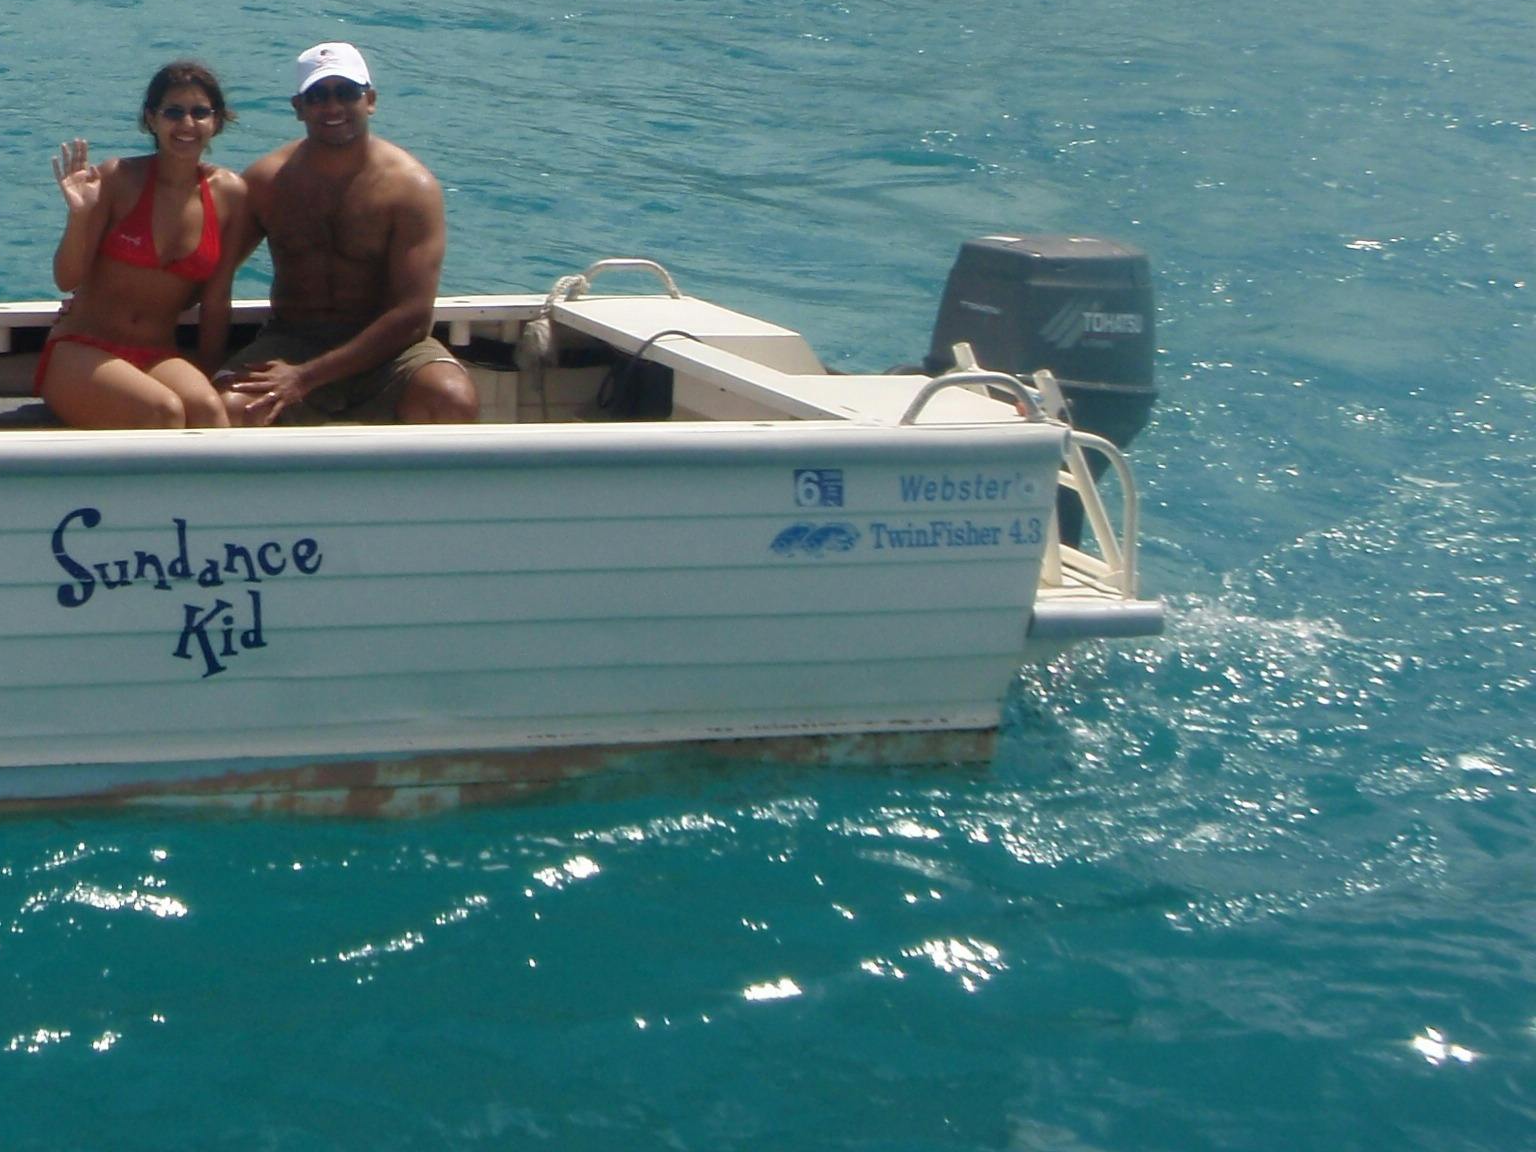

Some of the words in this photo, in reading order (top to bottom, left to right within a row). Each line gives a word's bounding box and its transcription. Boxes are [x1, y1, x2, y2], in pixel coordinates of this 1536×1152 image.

[898, 472, 1038, 503] Webster'
[51, 507, 323, 608] Sundance
[869, 519, 1002, 549] TwinFisher
[1007, 517, 1043, 545] 4.3
[172, 589, 267, 678] Kid
